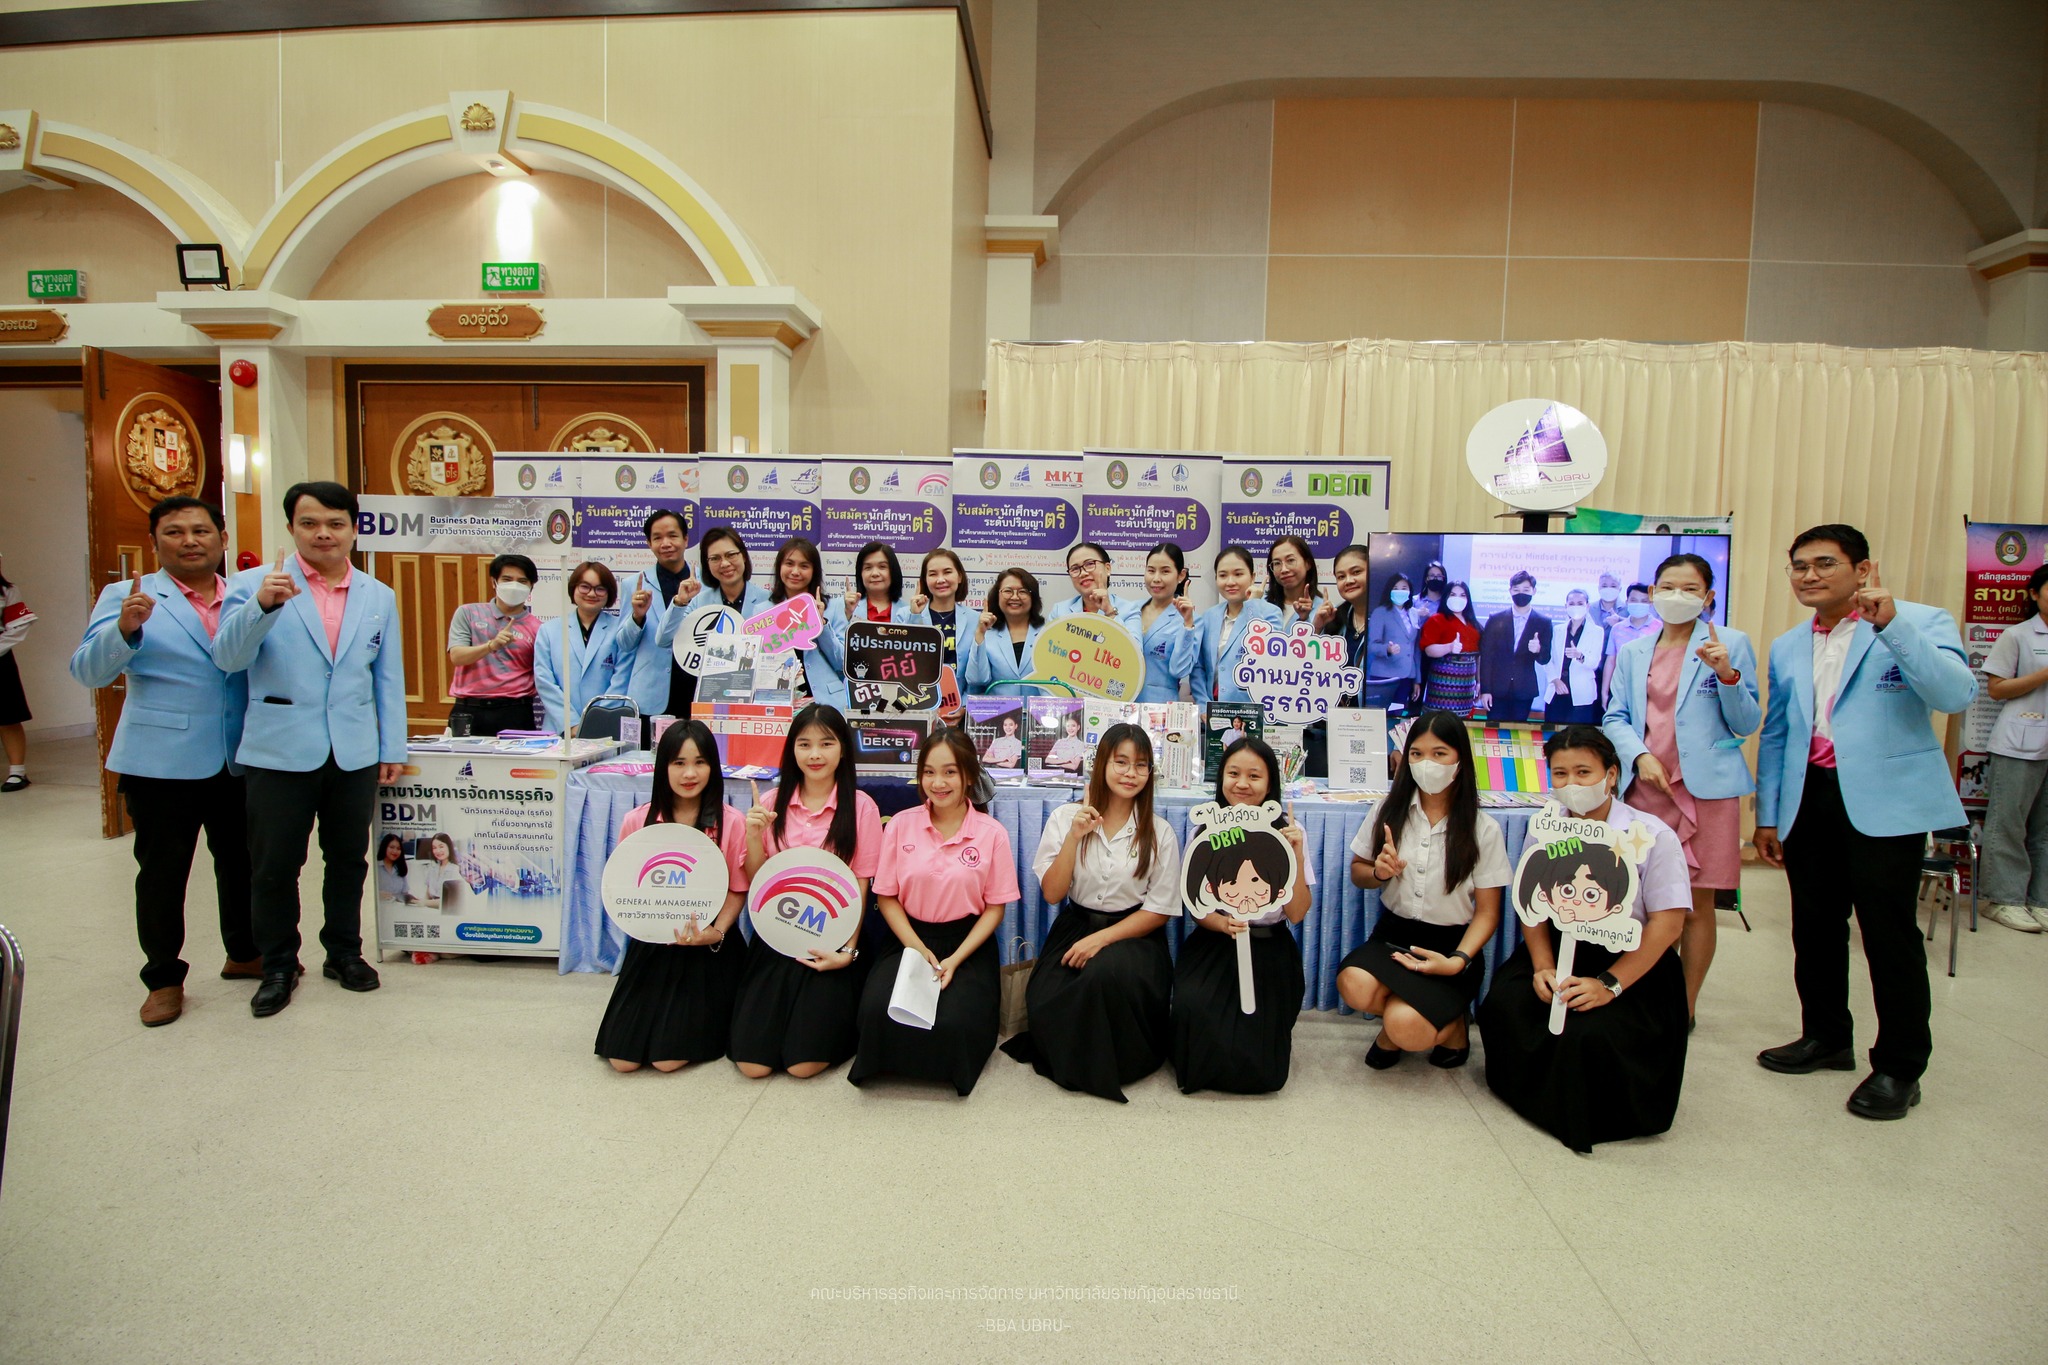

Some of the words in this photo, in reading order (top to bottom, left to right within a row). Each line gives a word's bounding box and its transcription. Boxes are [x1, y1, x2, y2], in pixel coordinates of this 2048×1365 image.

[43, 274, 74, 283] ทางออก
[500, 266, 535, 277] ทางออก
[47, 283, 72, 293] EXIT
[505, 276, 533, 286] EXIT
[1044, 470, 1083, 483] MKT
[1308, 473, 1372, 496] DBM
[924, 484, 944, 494] GM
[1173, 484, 1188, 492] IBM
[358, 511, 424, 537] BDM
[430, 516, 467, 525] Business
[470, 517, 490, 525] Data
[492, 518, 542, 527] Managment
[704, 505, 790, 520] รับสมัครนักศึกษา
[791, 505, 812, 531] ตรี
[825, 506, 912, 521] รับสมัครนักศึกษา
[912, 507, 933, 533] ตรี
[957, 502, 1044, 517] รับสมัครนักศึกษา
[1044, 503, 1066, 529] ตรี
[984, 515, 1044, 530] ระดับปริญญา
[1087, 503, 1175, 518] รับสมัครนักศึกษา
[1175, 503, 1197, 530] ตรี
[1115, 516, 1175, 531] ระดับปริญญา
[1226, 511, 1317, 525] รับสมัครนักศึกษา
[1317, 510, 1340, 537] ตรี
[429, 527, 543, 539] สาขาวิชาการจัดการข้อมูลธุรกิจ
[731, 518, 790, 533] ระดับปริญญา
[852, 519, 912, 534] ระดับปริญญา
[1254, 523, 1317, 538] ระดับปริญญา
[1525, 552, 1558, 561] Mindset
[745, 615, 776, 635] CME
[888, 627, 908, 635] cme
[850, 633, 937, 652] ผู้ประกอบการ
[1247, 624, 1342, 662] จัดจ้าน
[682, 651, 700, 670] IB
[880, 652, 917, 680] ดีย์
[1093, 647, 1122, 670] Like
[1069, 665, 1103, 689] Love
[1239, 658, 1358, 689] ด้านบริหาร
[1261, 688, 1328, 721] ธุรกิจ
[753, 722, 784, 735] BBA
[1249, 721, 1257, 730] 3
[862, 737, 915, 747] DEK'67
[379, 784, 554, 806] สาขาวิชาการจัดการธุรกิจ
[381, 803, 437, 821] BDM
[527, 808, 553, 819] (ธุรกิจ)
[1206, 806, 1260, 825] ไหว้สวย
[1535, 806, 1605, 839] เยี่ยมยอด
[1209, 826, 1246, 851] DBM
[1545, 836, 1583, 860] DBM
[650, 869, 687, 885] GM
[615, 897, 652, 906] GENERAL
[654, 899, 713, 908] MANAGEMENT
[777, 896, 828, 934] GM
[794, 924, 822, 938] MANAGEMENT
[1576, 921, 1634, 945] เก่งมากลูกพี่
